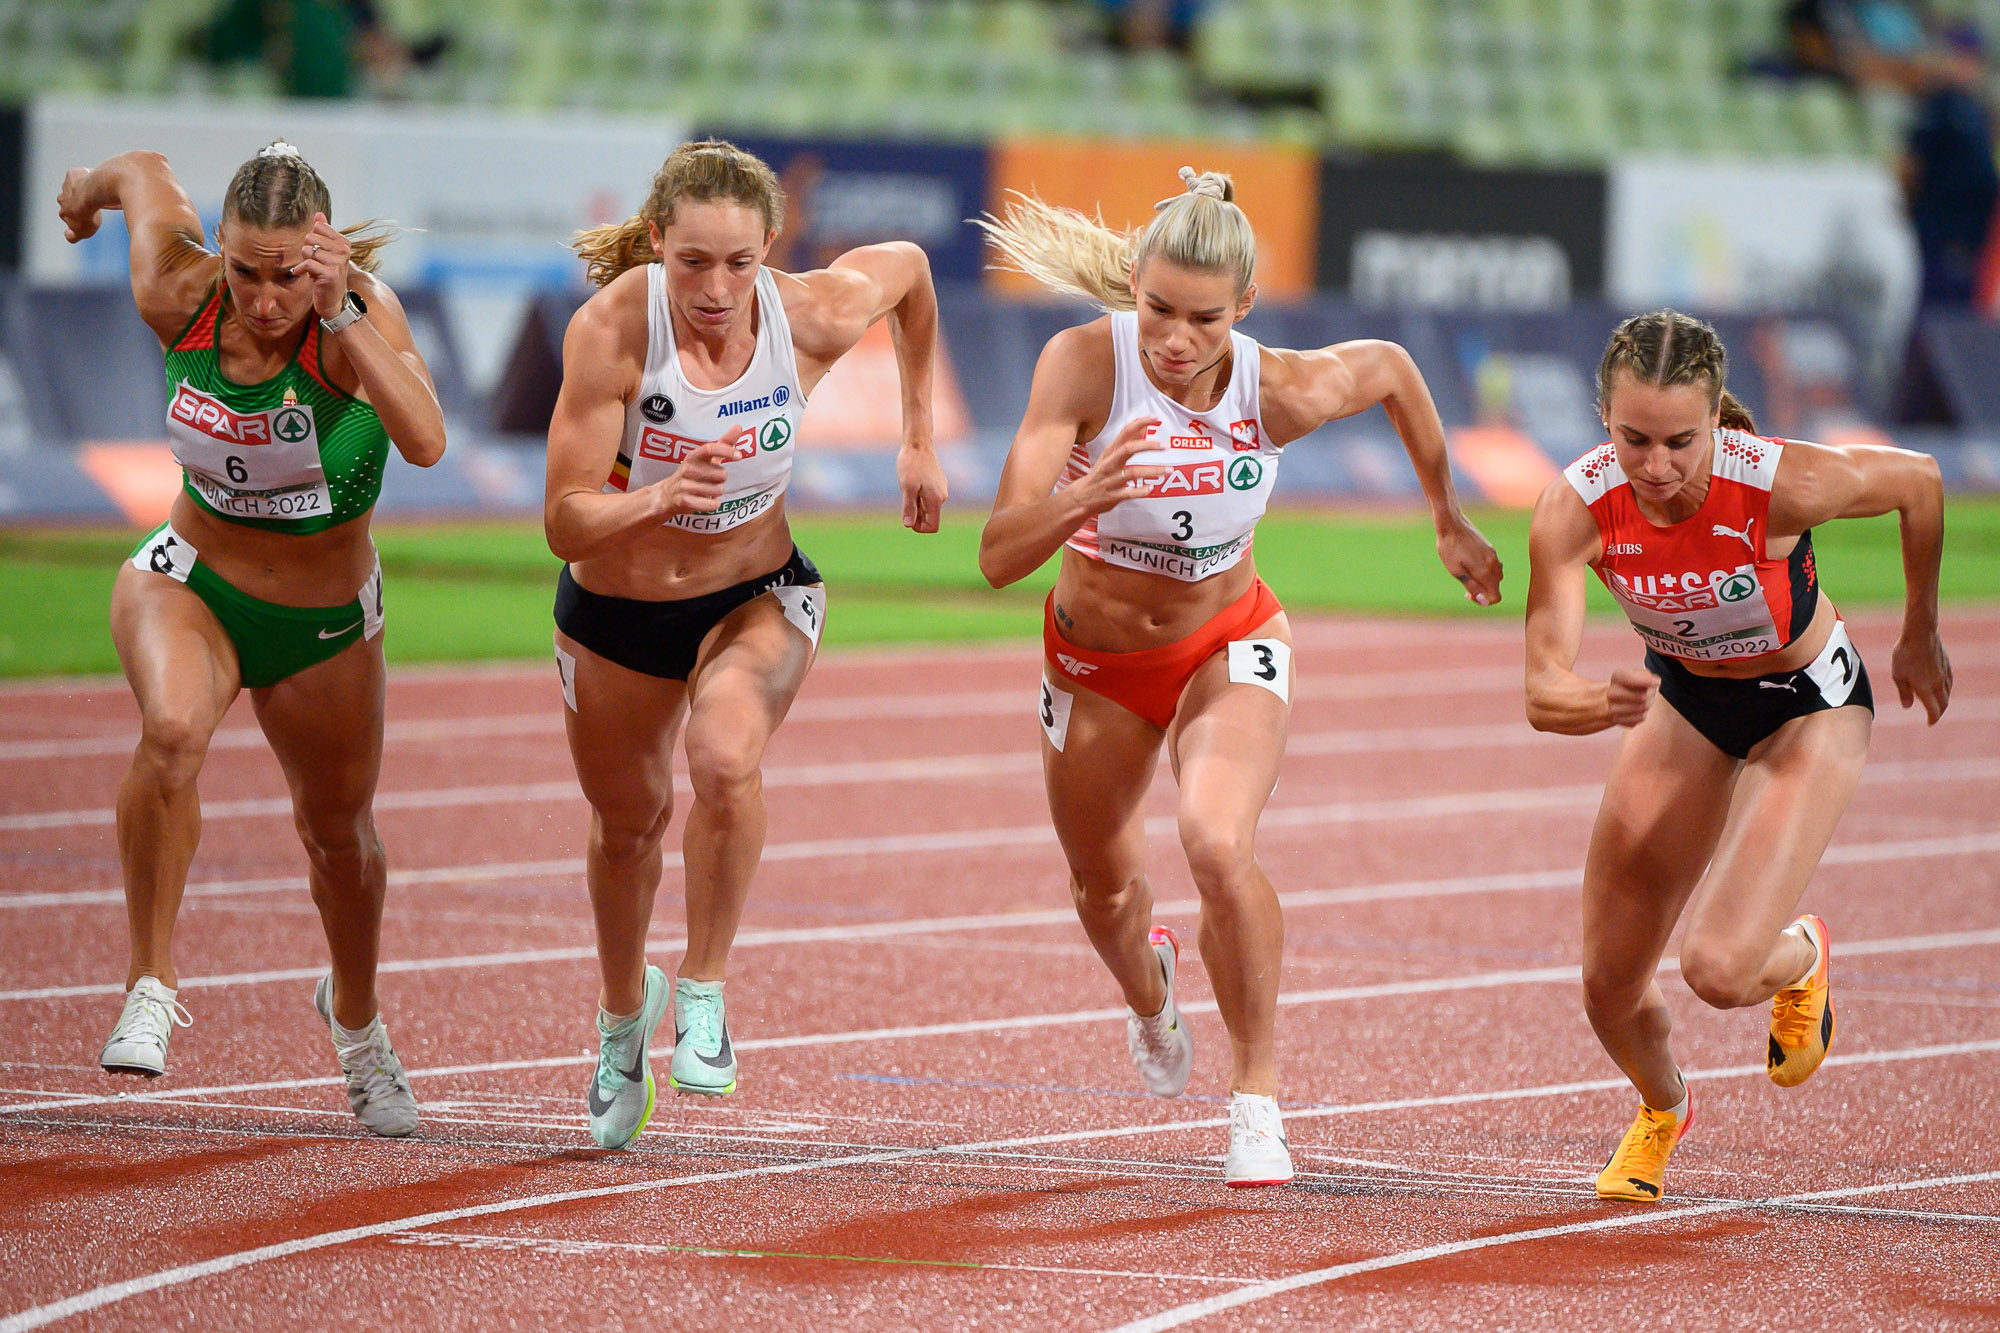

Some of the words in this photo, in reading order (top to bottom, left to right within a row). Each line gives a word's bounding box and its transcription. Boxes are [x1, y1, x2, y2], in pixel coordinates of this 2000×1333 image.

[175, 393, 268, 441] SPAR
[717, 396, 771, 419] Allianz
[1172, 438, 1211, 449] ORLEN
[225, 455, 249, 483] 6
[1126, 466, 1221, 493] PAR
[194, 473, 259, 514] MUNICH
[267, 493, 321, 515] 2022
[670, 514, 720, 530] NICH
[727, 493, 770, 527] 2022
[1171, 511, 1194, 541] 3
[1110, 543, 1194, 577] MUNICH
[1617, 543, 1643, 555] UBS
[1611, 575, 1715, 610] SPAR
[1673, 620, 1699, 637] 2
[1690, 632, 1733, 648] CLEAN
[1718, 639, 1770, 656] 2022
[1056, 653, 1099, 676] 4F
[1252, 644, 1278, 681] 3
[1041, 681, 1054, 728] 3
